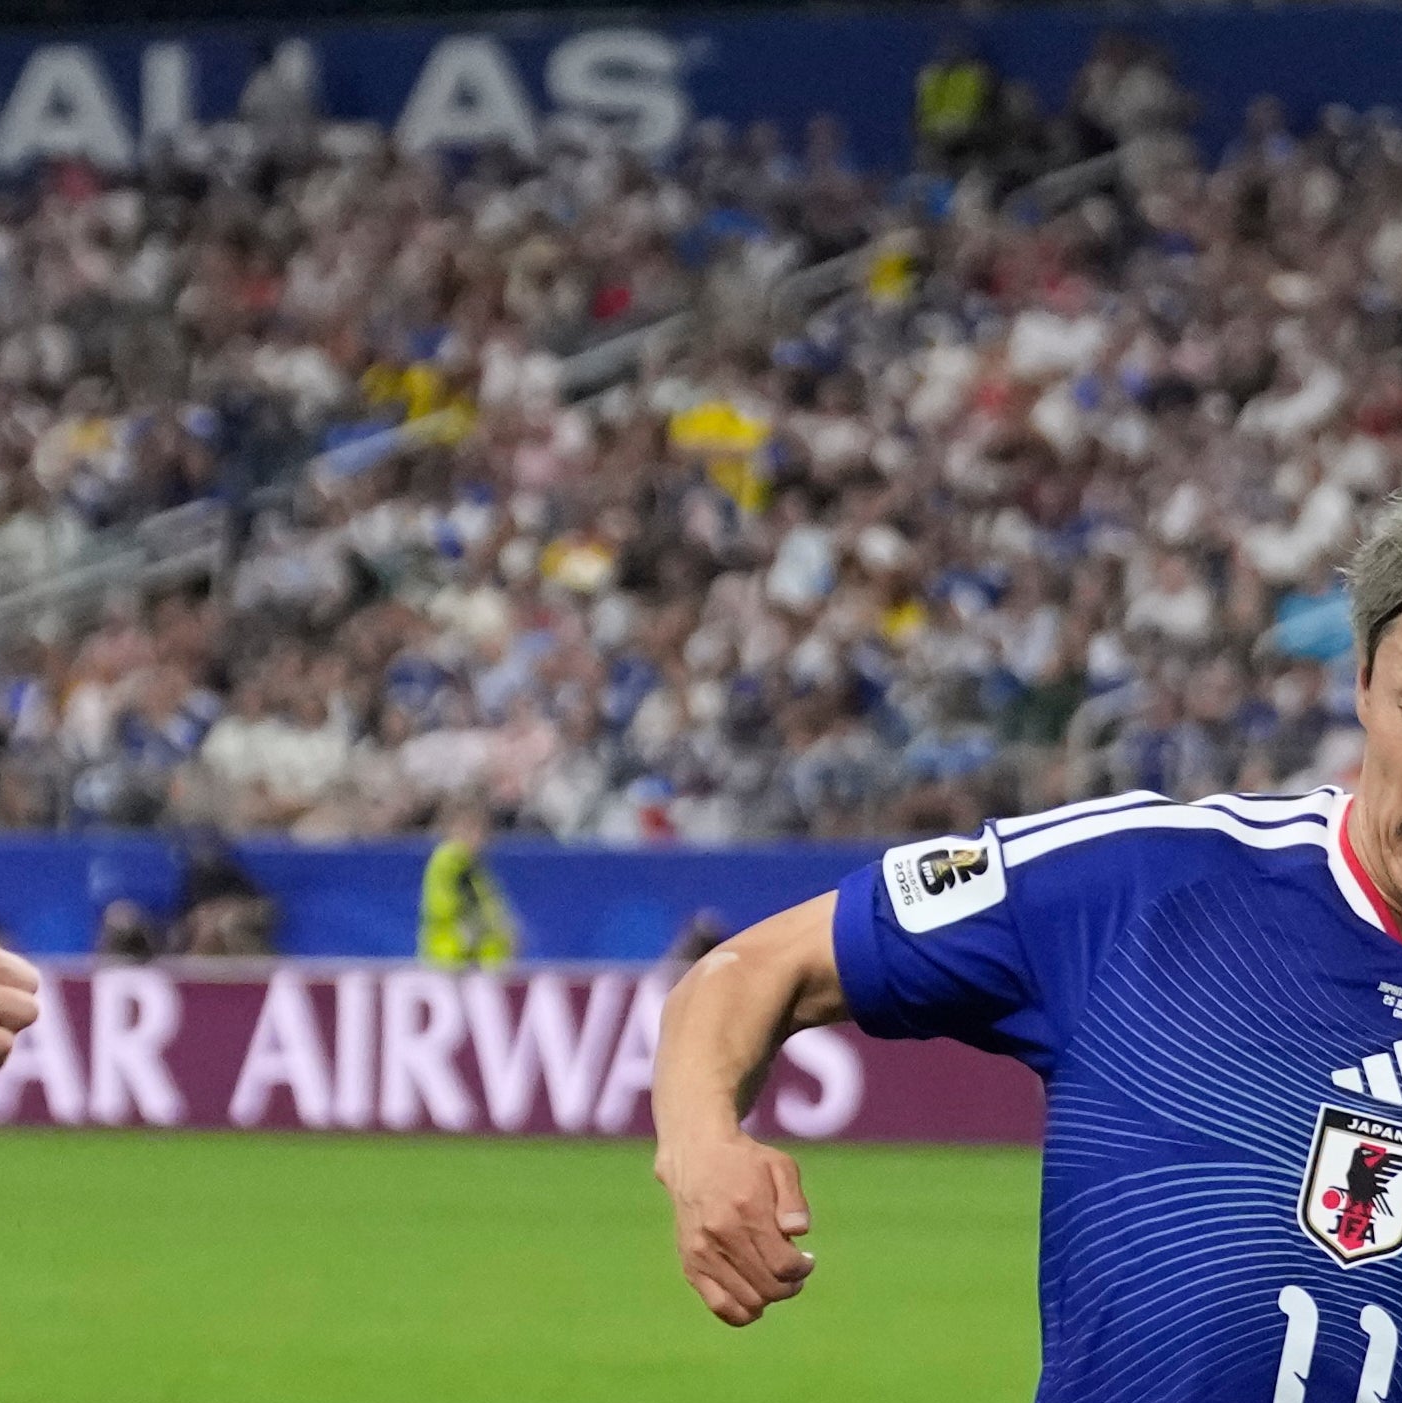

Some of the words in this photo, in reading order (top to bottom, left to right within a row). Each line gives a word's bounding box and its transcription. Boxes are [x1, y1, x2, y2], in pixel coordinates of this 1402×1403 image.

[894, 861, 915, 906] 2026
[229, 967, 864, 1136] AIRWAS
[1327, 1214, 1377, 1245] JFA
